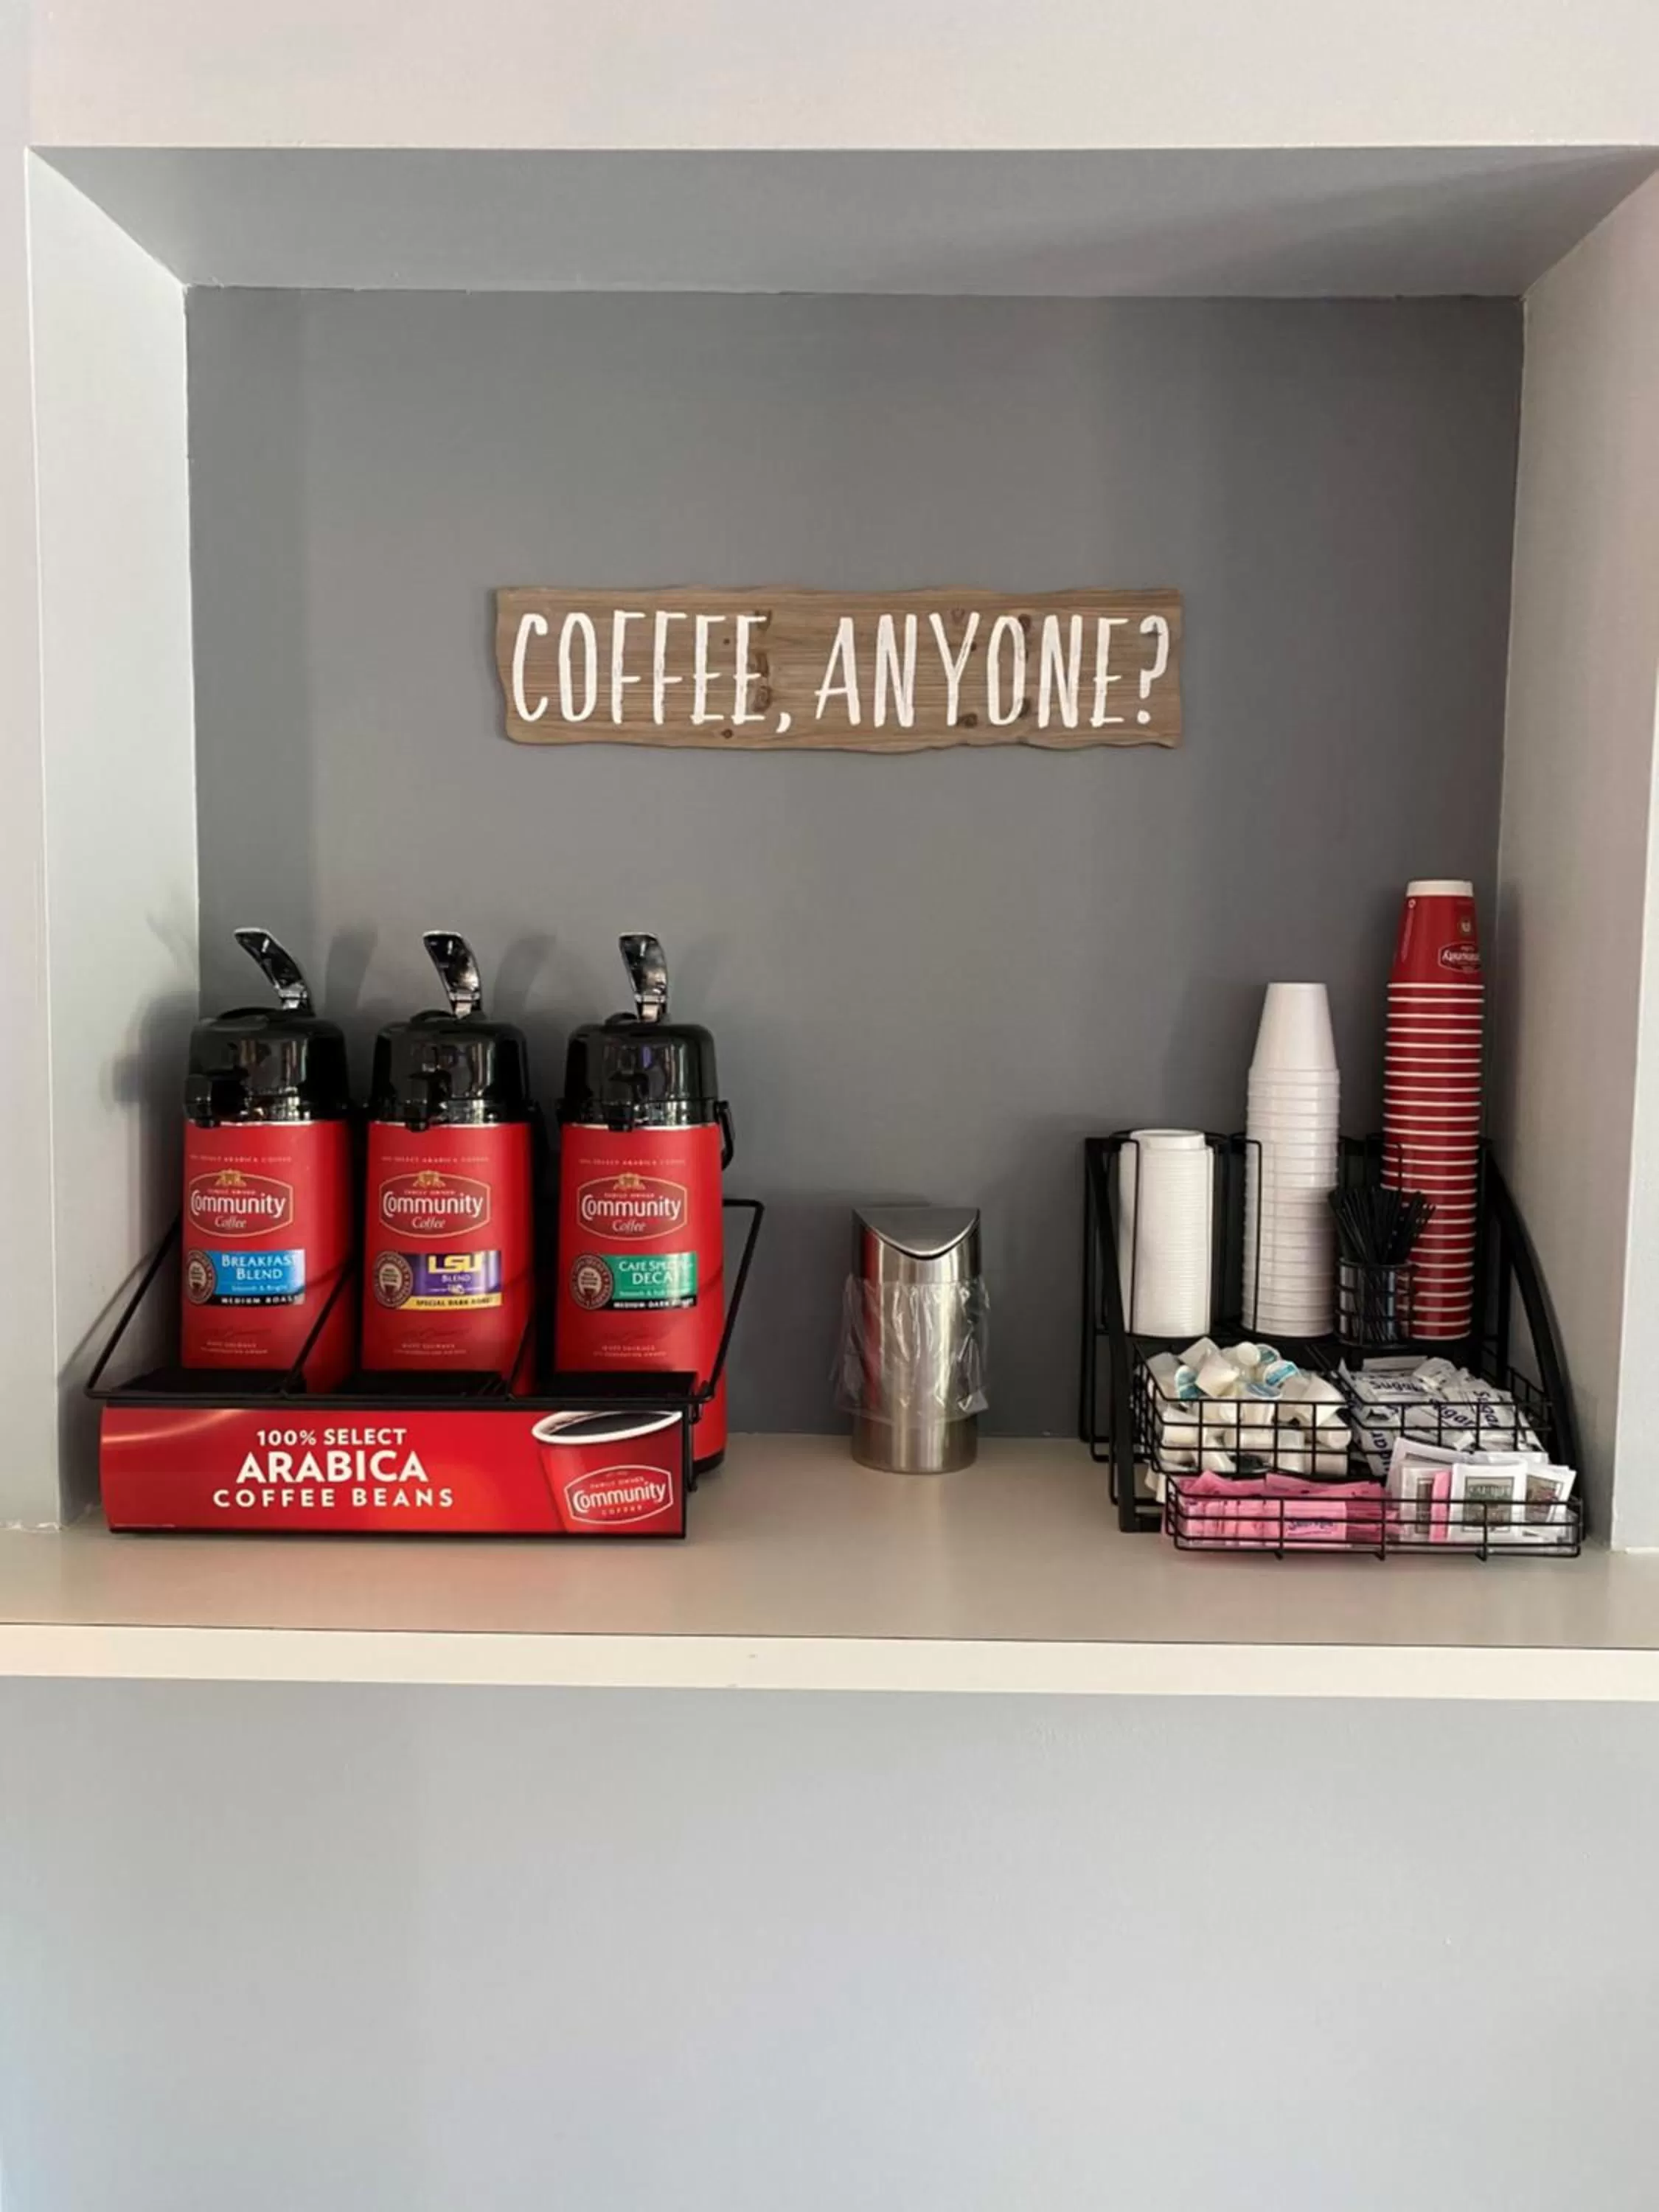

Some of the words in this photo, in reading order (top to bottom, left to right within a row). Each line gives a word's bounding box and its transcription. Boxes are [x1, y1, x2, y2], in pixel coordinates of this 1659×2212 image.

[512, 611, 791, 734] COFFEE,
[815, 611, 1171, 729] ANYONE?
[191, 1189, 287, 1219] Community
[383, 1191, 484, 1218] Community
[582, 1194, 681, 1221] Community
[215, 1215, 247, 1228] Coffee
[412, 1217, 446, 1229] Coffee
[612, 1219, 646, 1234] Coffee
[428, 1253, 484, 1273] LSU
[236, 1267, 283, 1281] BLEND
[442, 1273, 471, 1283] BLEND
[632, 1271, 678, 1285] DECA
[257, 1429, 317, 1446] 100%
[324, 1428, 407, 1445] SELECT
[236, 1450, 428, 1484] ARABICA
[212, 1489, 335, 1508] COFFEE
[351, 1488, 453, 1507] BEANS
[572, 1481, 666, 1513] Community
